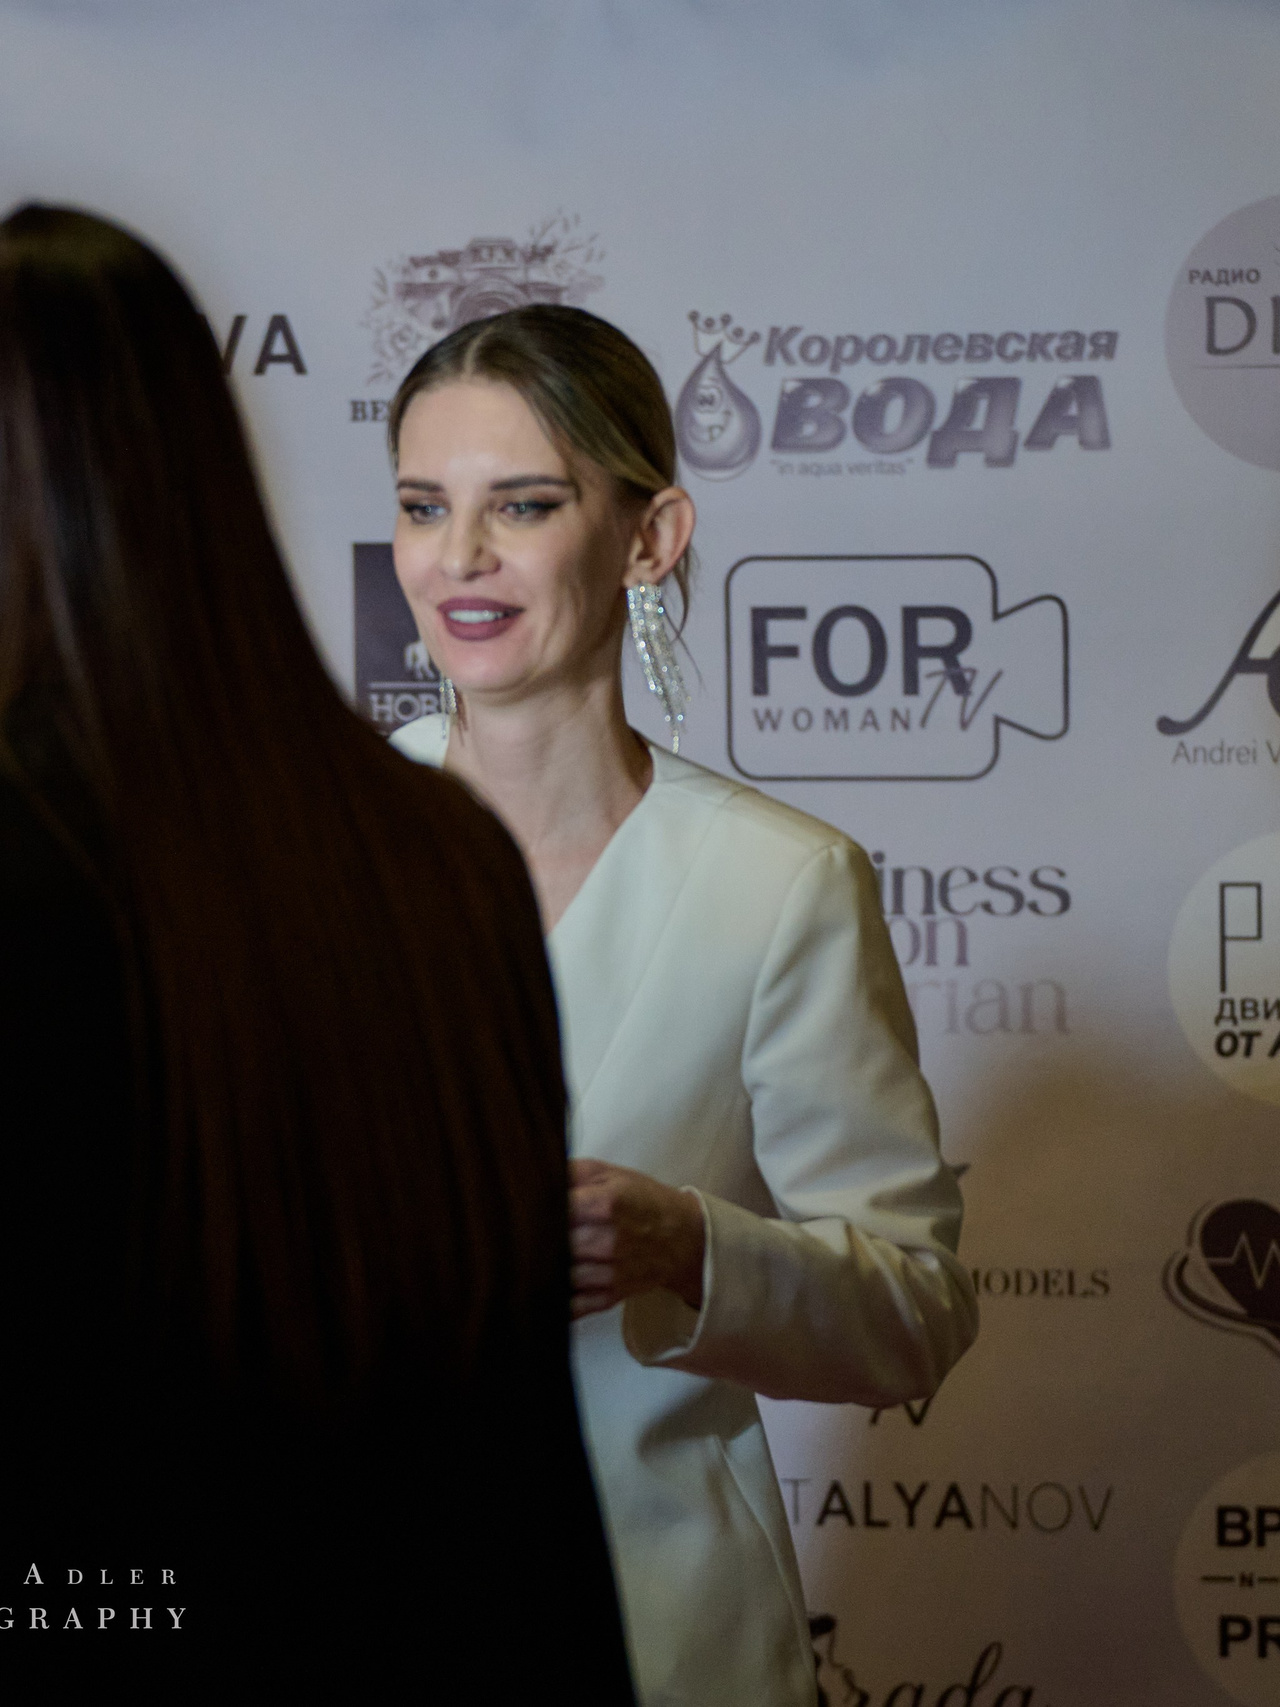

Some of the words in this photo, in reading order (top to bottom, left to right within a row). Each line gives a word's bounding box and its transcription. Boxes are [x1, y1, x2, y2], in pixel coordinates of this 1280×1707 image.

[1188, 268, 1261, 286] РАДИО
[764, 326, 1119, 374] Королевская
[770, 375, 1113, 469] ВОДА
[750, 604, 973, 697] FOR
[753, 706, 913, 733] WOMAN
[1171, 739, 1258, 766] Andrei
